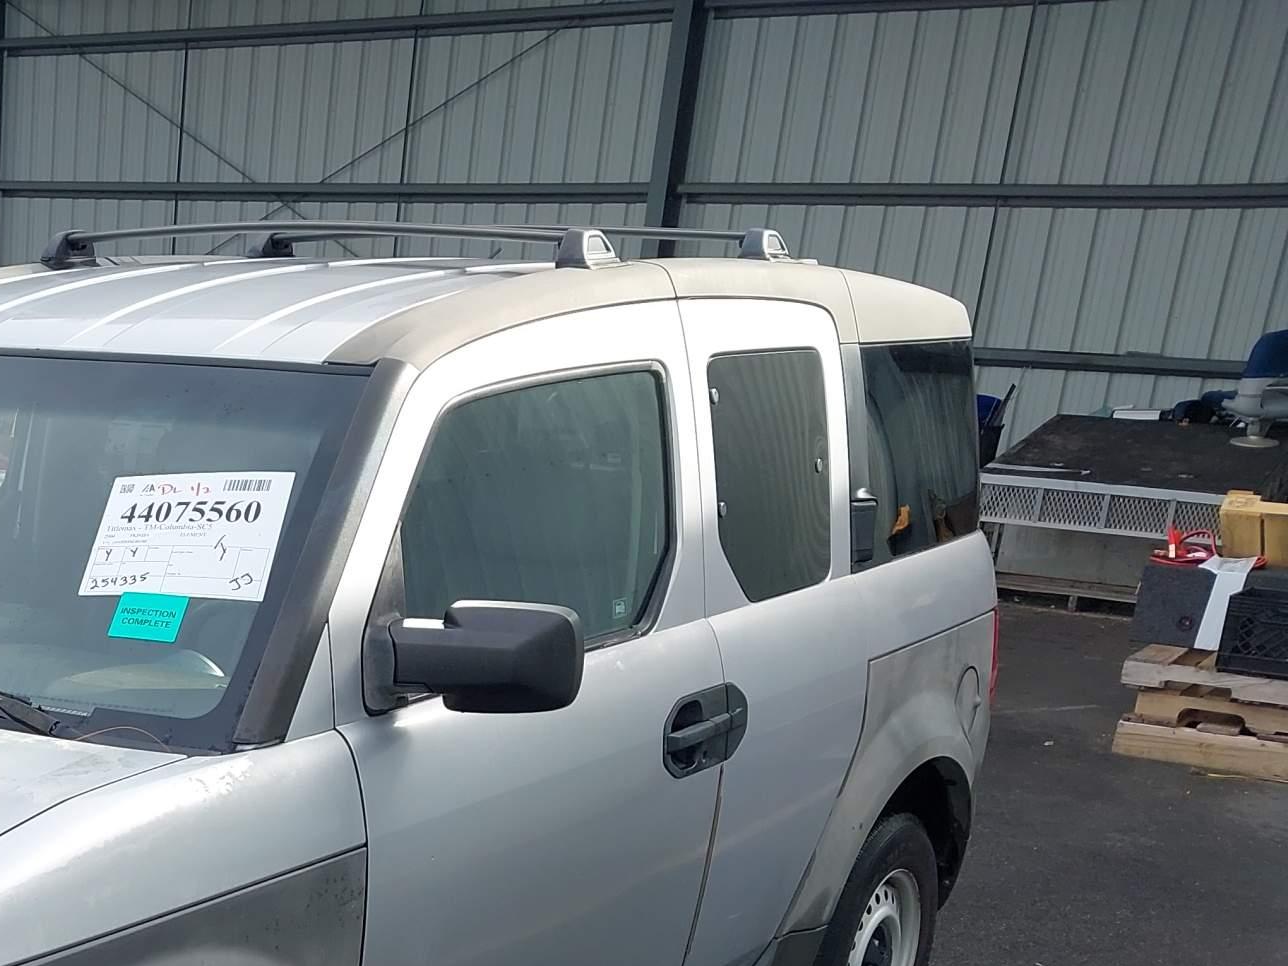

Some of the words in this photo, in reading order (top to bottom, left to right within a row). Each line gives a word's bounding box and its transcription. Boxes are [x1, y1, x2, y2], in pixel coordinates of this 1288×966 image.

[120, 500, 261, 523] 44075560
[90, 572, 150, 589] 254335
[121, 607, 176, 618] INSPECTION
[121, 617, 172, 629] COMPLETE
